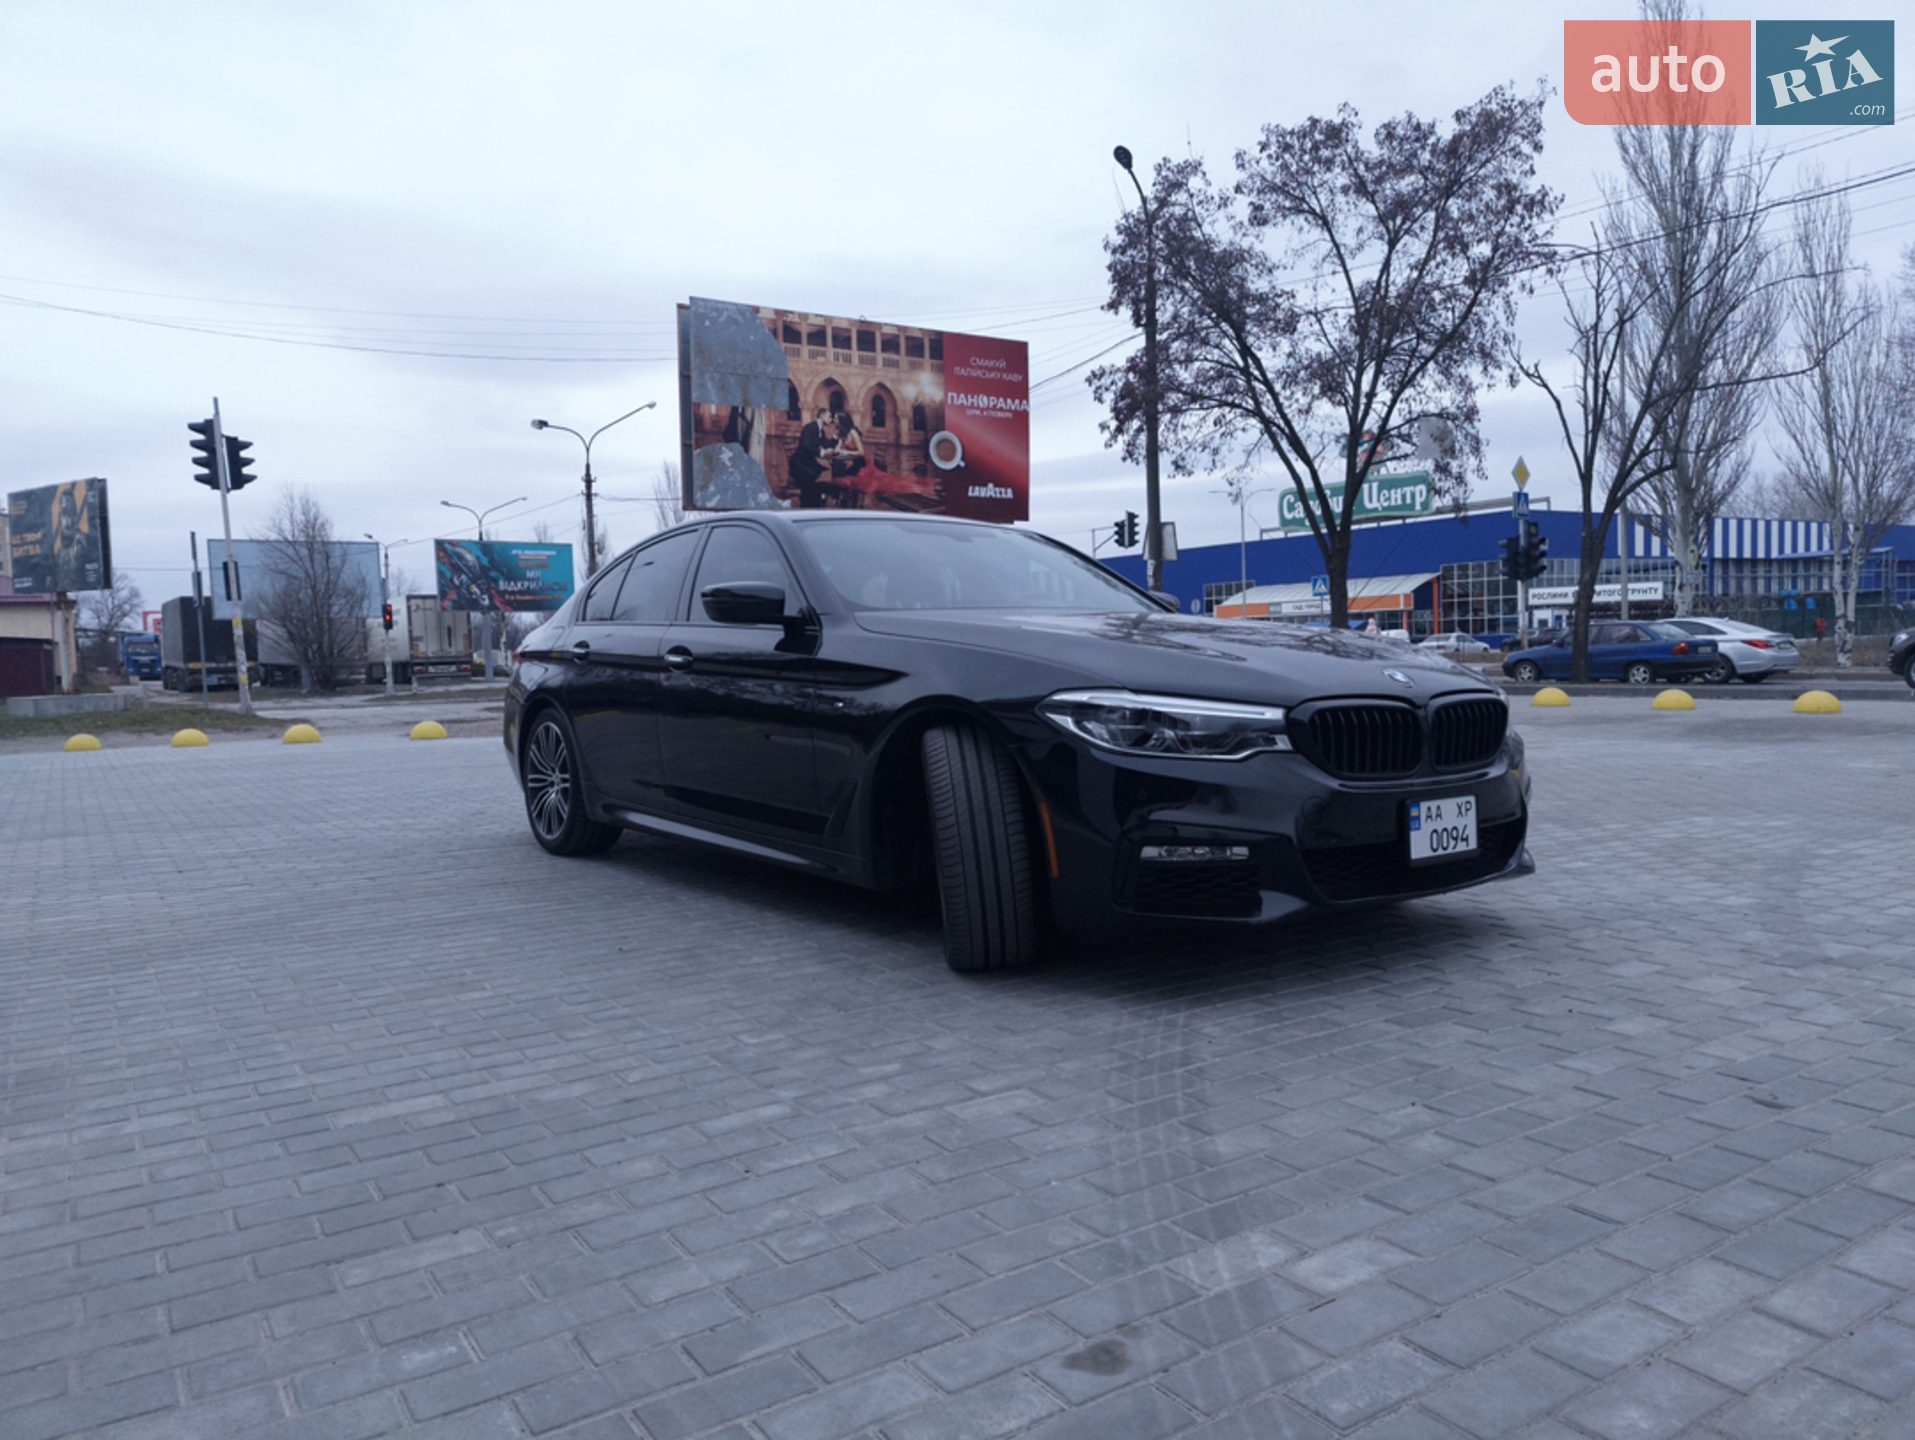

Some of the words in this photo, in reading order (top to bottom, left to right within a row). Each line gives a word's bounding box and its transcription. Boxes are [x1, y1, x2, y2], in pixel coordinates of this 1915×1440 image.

[969, 356, 1007, 369] СМАКУЙ
[1002, 372, 1024, 382] КАВУ
[947, 391, 1029, 412] ПАНОРАМА
[968, 482, 1014, 499] LAVAZZA
[1363, 482, 1427, 511] Центр
[1531, 591, 1569, 600] РОСЛИНИ
[1425, 804, 1443, 823] AA
[1456, 800, 1473, 818] XP
[1429, 824, 1470, 853] 0094
